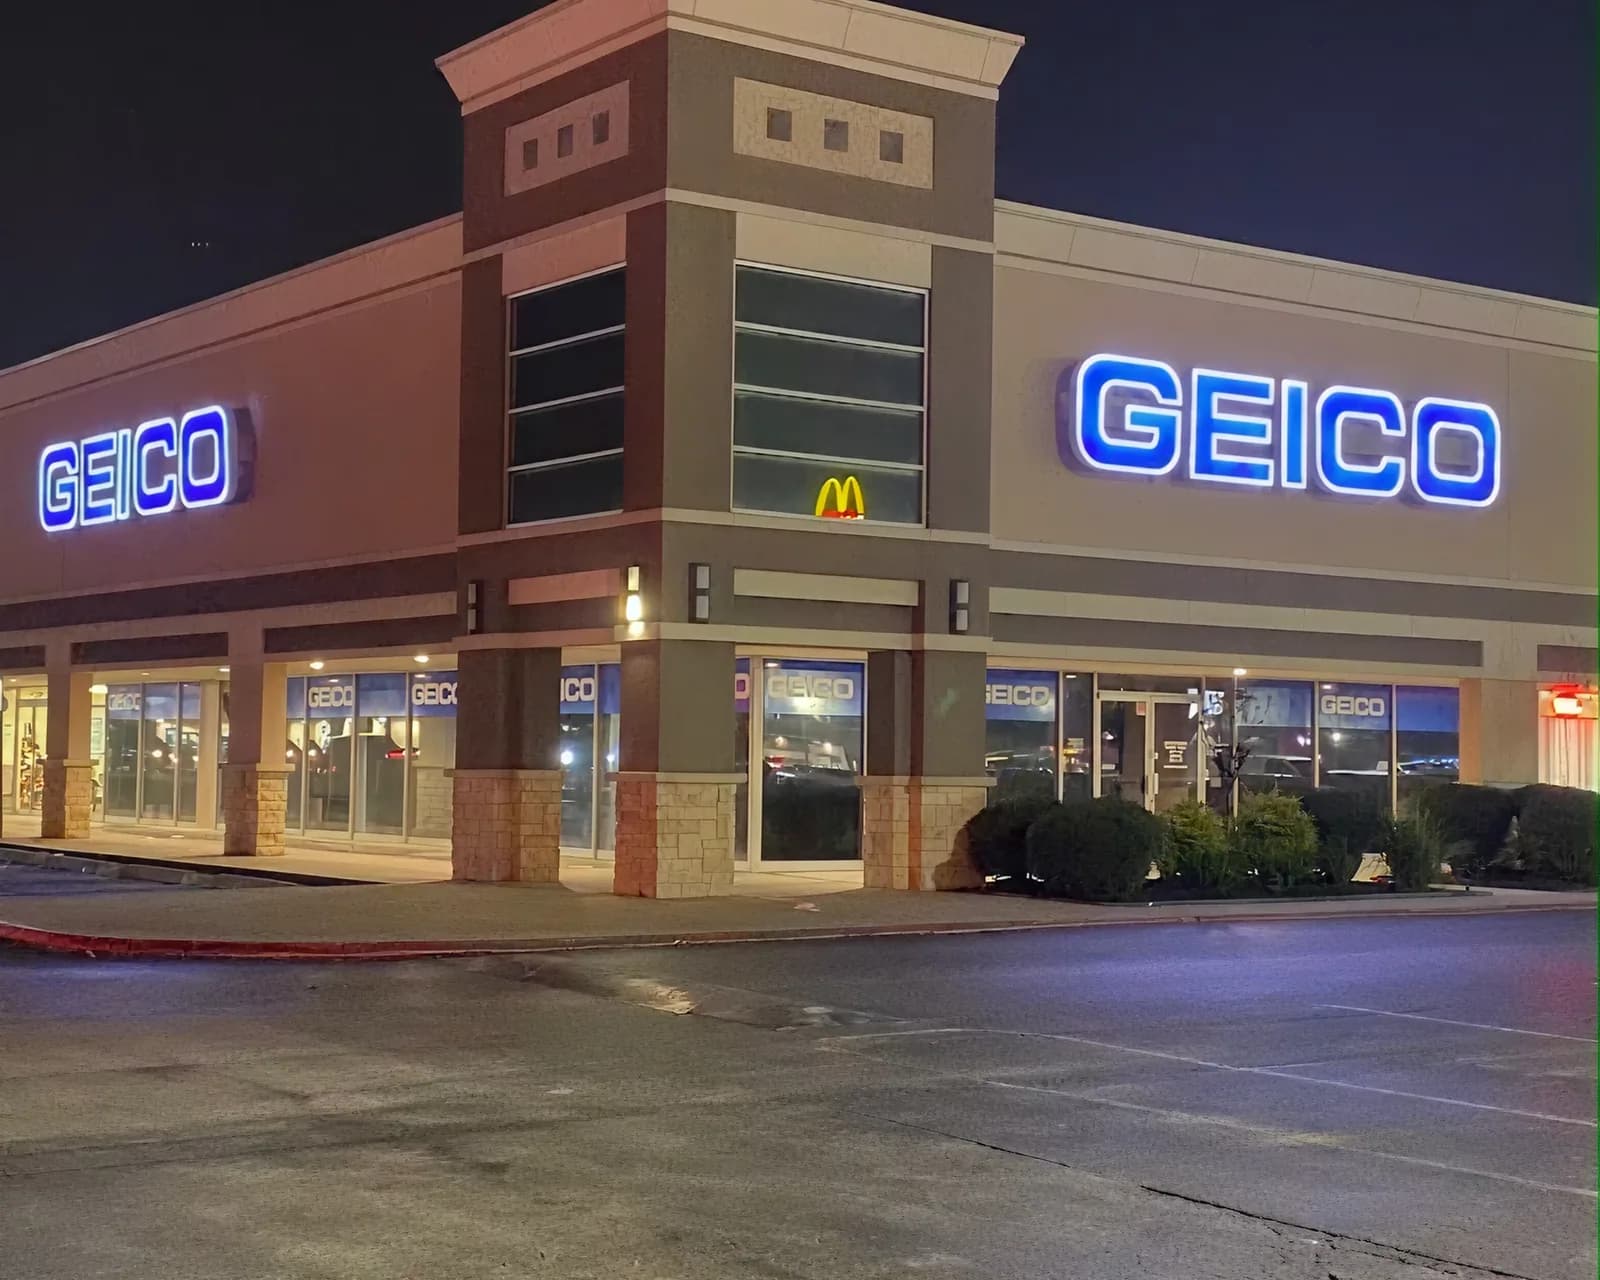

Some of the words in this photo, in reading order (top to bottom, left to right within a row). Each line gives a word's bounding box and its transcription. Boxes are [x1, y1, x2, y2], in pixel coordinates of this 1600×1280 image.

[39, 405, 229, 532] GEICO
[1076, 353, 1501, 508] GEICO
[560, 677, 596, 702] ICO
[1321, 695, 1385, 717] GEICO
